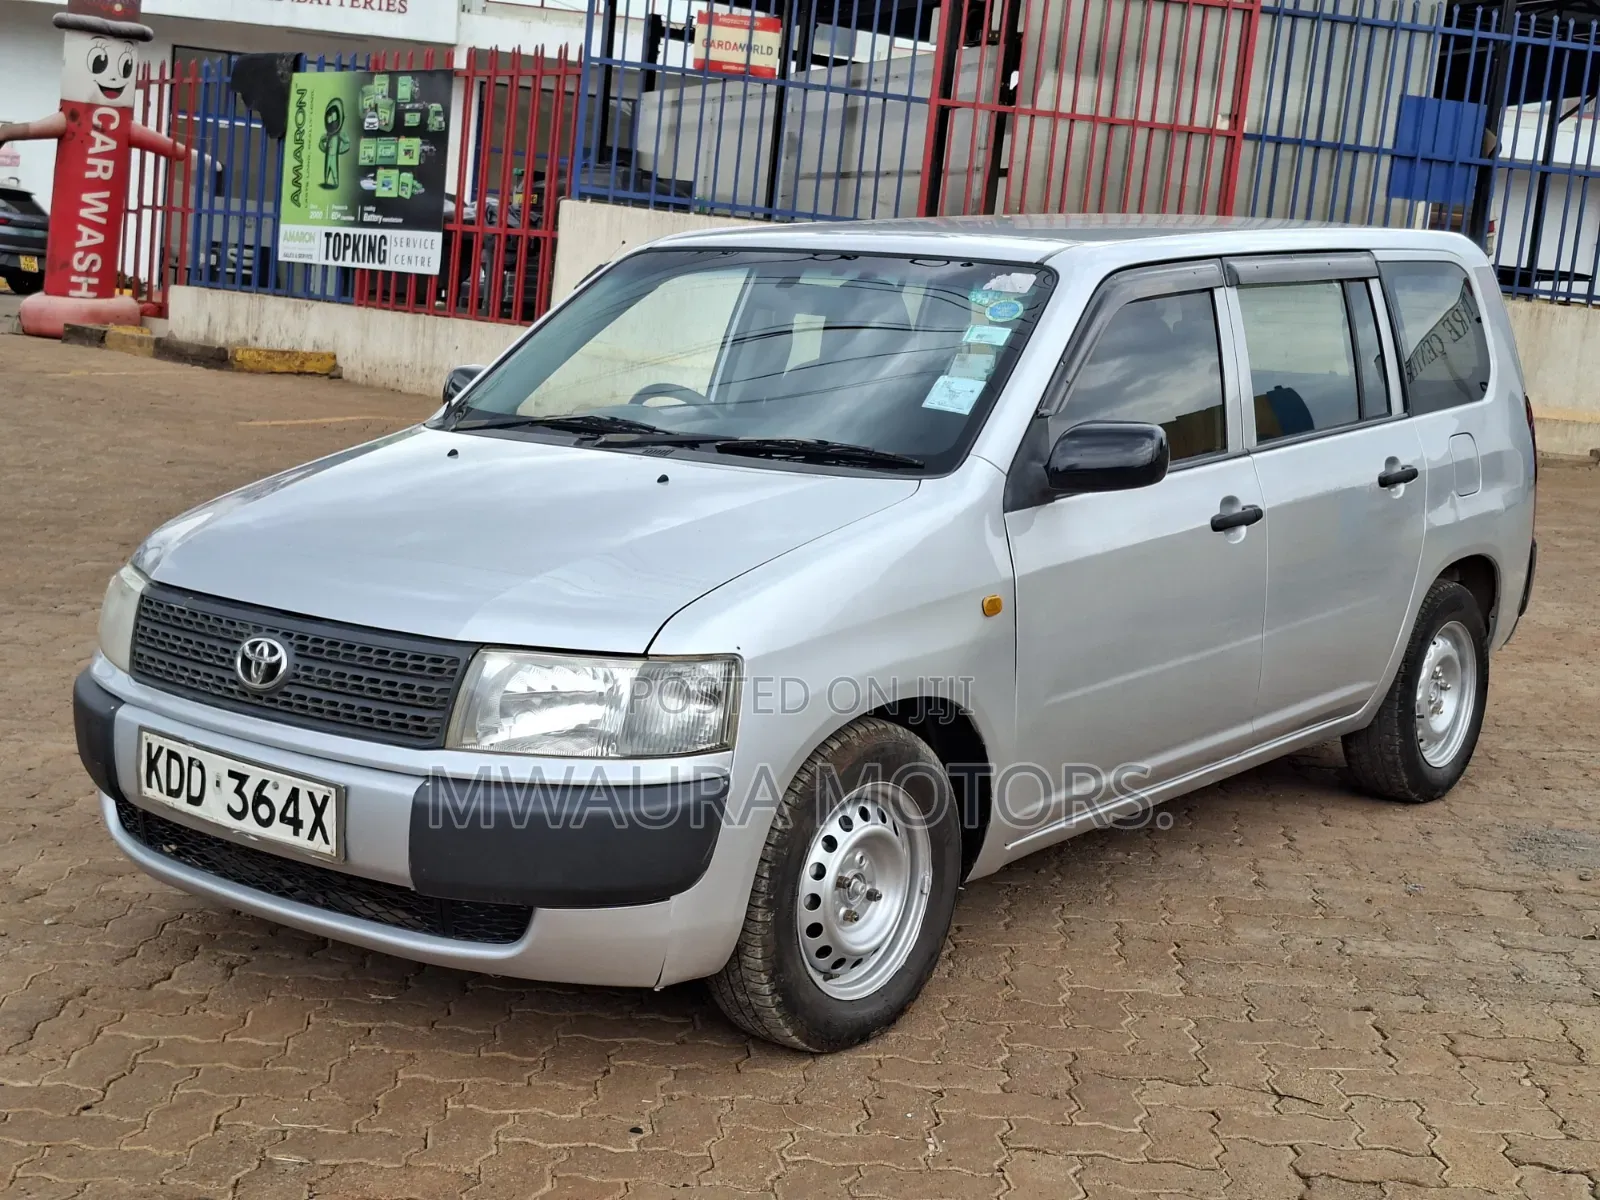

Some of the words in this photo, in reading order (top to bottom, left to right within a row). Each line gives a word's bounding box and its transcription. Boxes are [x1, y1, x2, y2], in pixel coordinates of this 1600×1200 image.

[296, 0, 408, 13] ERIES
[702, 39, 773, 56] GARDAWRLD
[84, 106, 120, 181] CAR
[291, 88, 307, 208] AMARON
[68, 191, 111, 298] WASH
[325, 232, 387, 265] TOPKING
[394, 236, 435, 250] SERVICE
[394, 254, 431, 267] CENTRE
[145, 742, 206, 807] KDD
[226, 769, 330, 845] 364X
